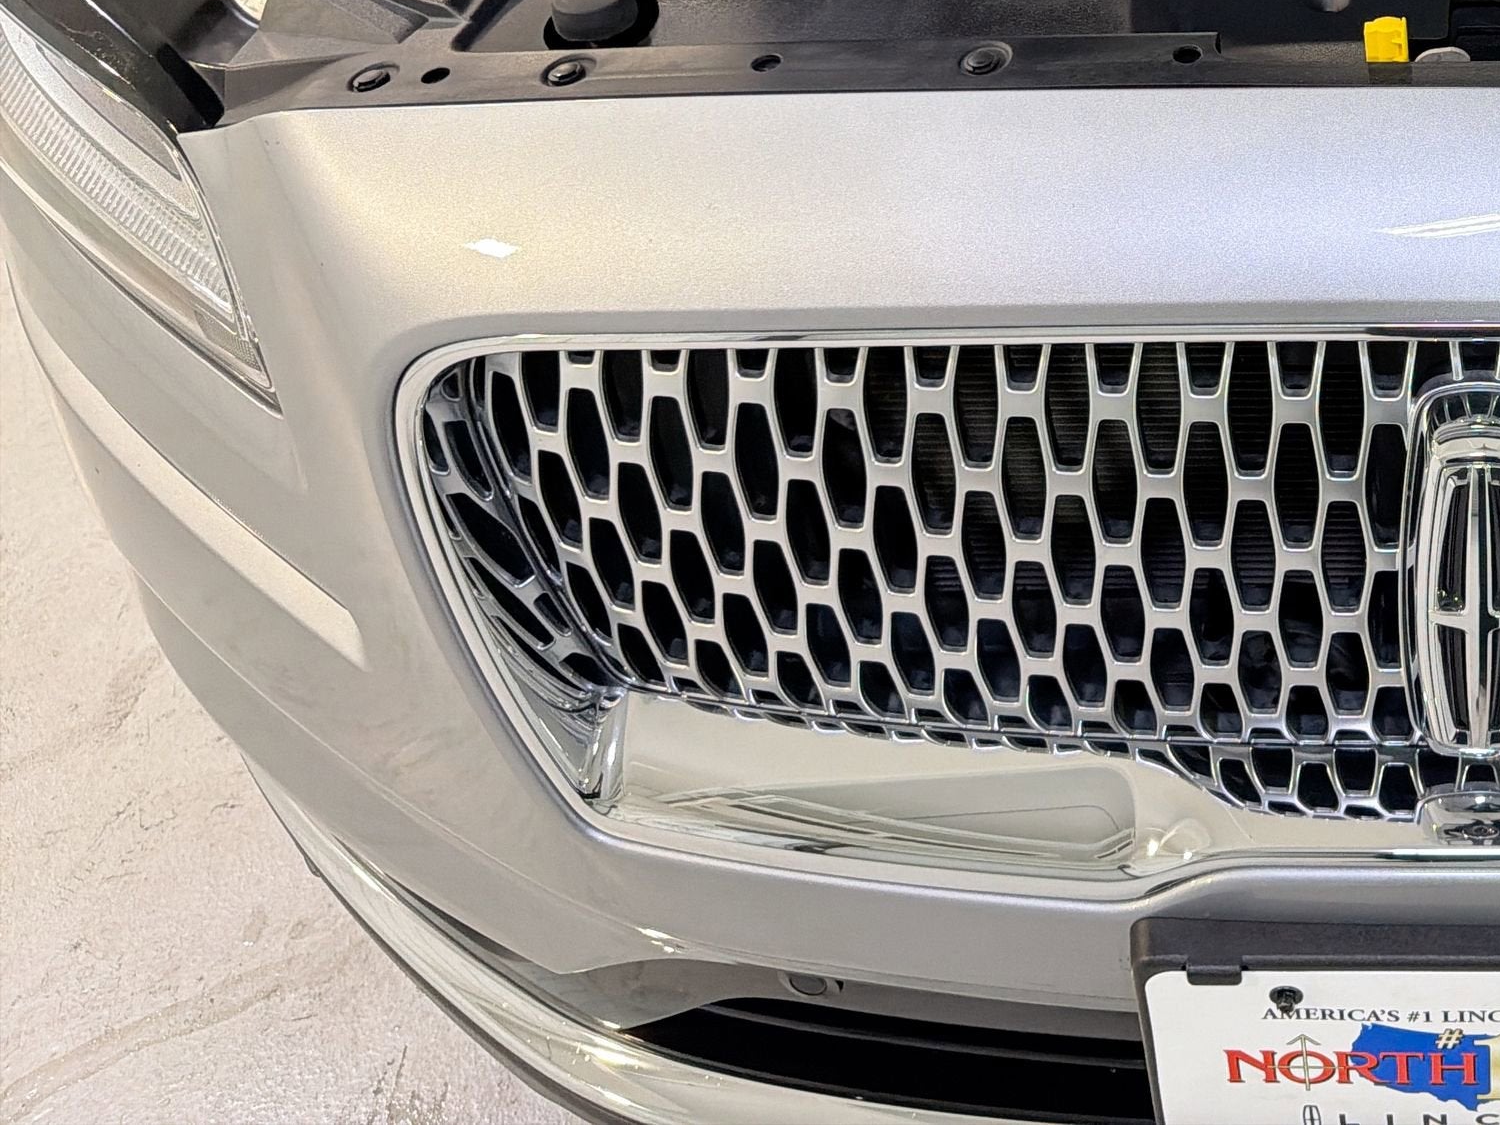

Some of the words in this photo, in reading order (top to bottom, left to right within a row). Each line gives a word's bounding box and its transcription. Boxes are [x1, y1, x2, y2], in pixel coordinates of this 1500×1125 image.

[1261, 1007, 1401, 1023] AMERICA'S
[1406, 1010, 1433, 1024] #1
[1223, 1049, 1478, 1087] NORTH
